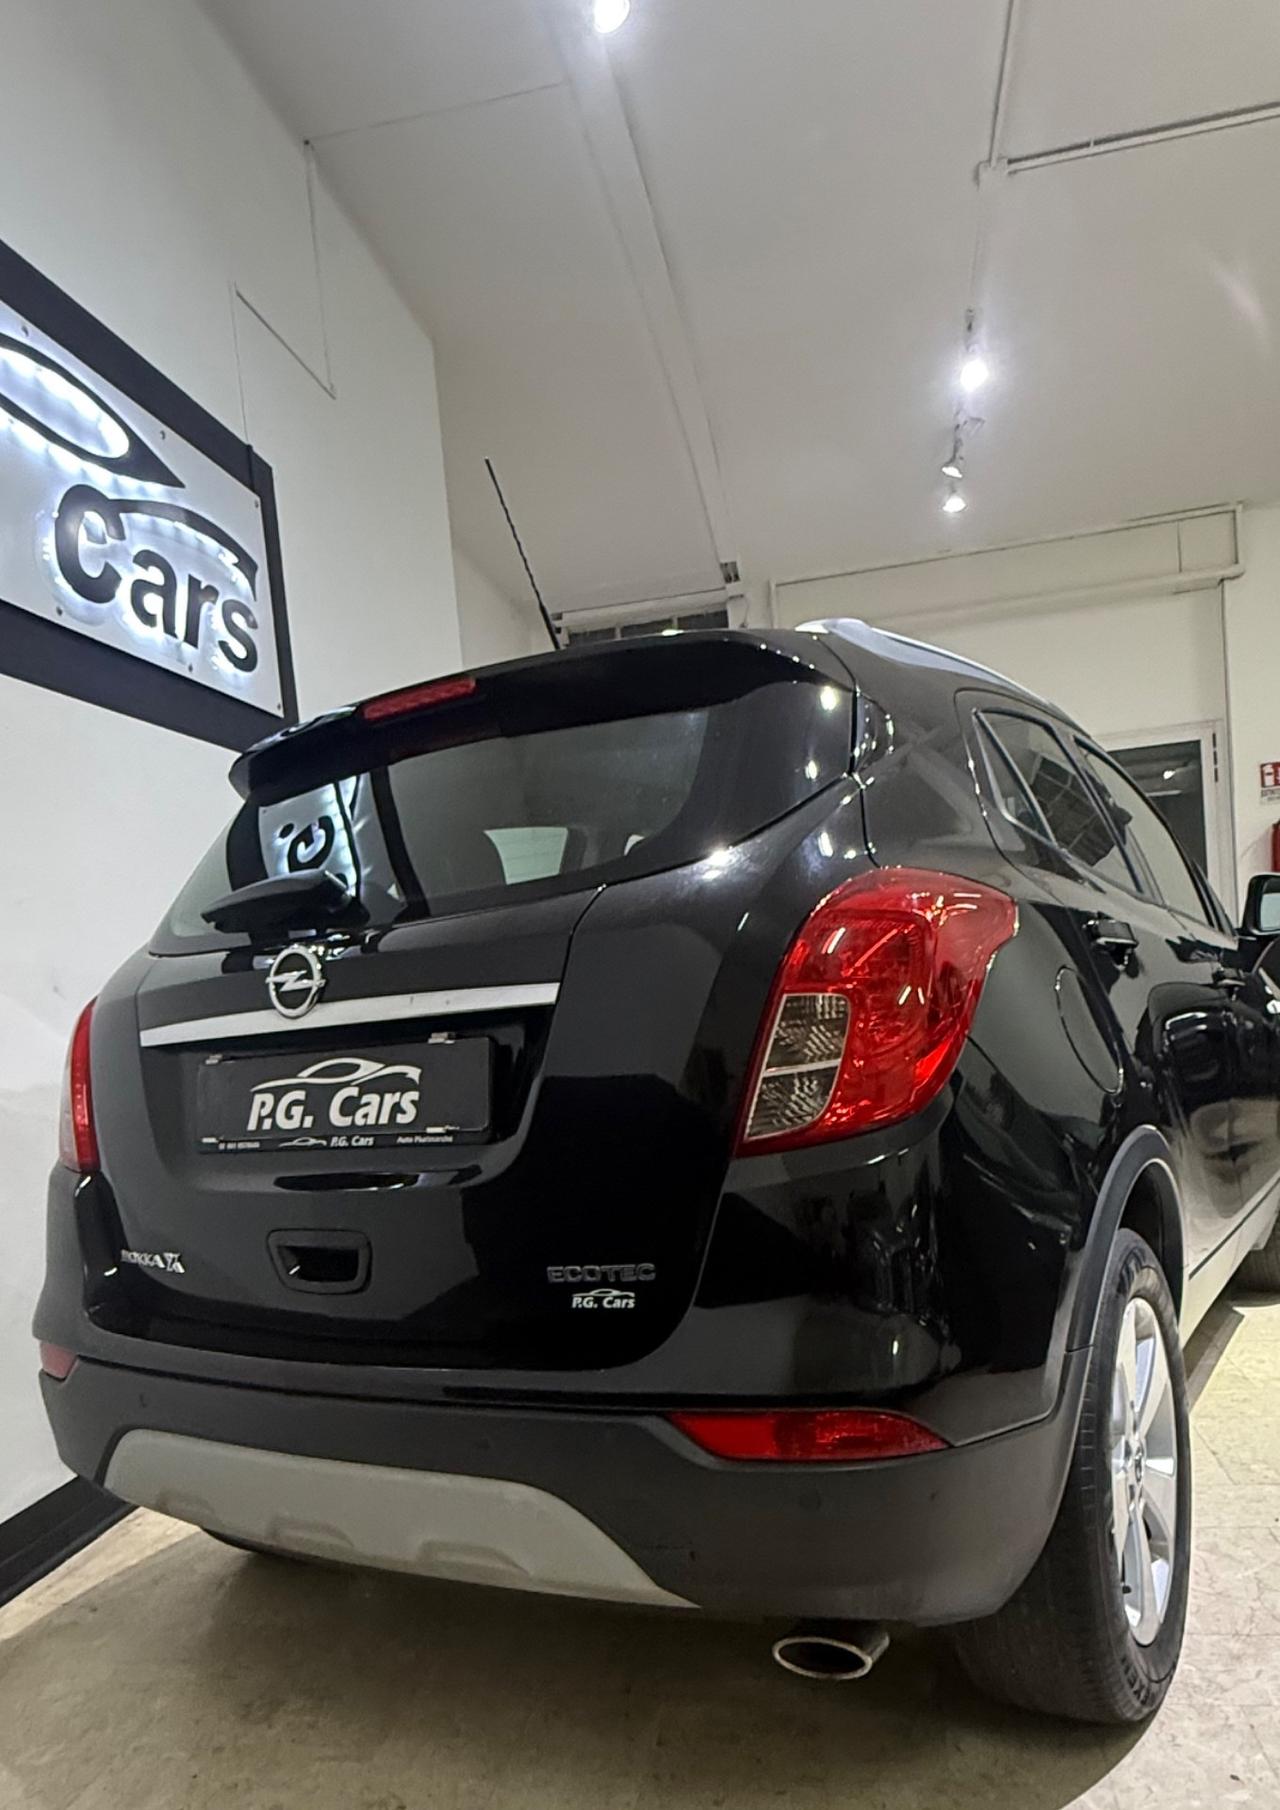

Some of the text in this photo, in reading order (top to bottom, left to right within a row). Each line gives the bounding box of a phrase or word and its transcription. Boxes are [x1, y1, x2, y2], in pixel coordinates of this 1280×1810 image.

[55, 484, 259, 674] Cars
[247, 1086, 420, 1131] P.G. Cars
[351, 1135, 375, 1147] Cars
[546, 1263, 656, 1282] ECOTEC
[572, 1297, 635, 1308] P.G. Cars
